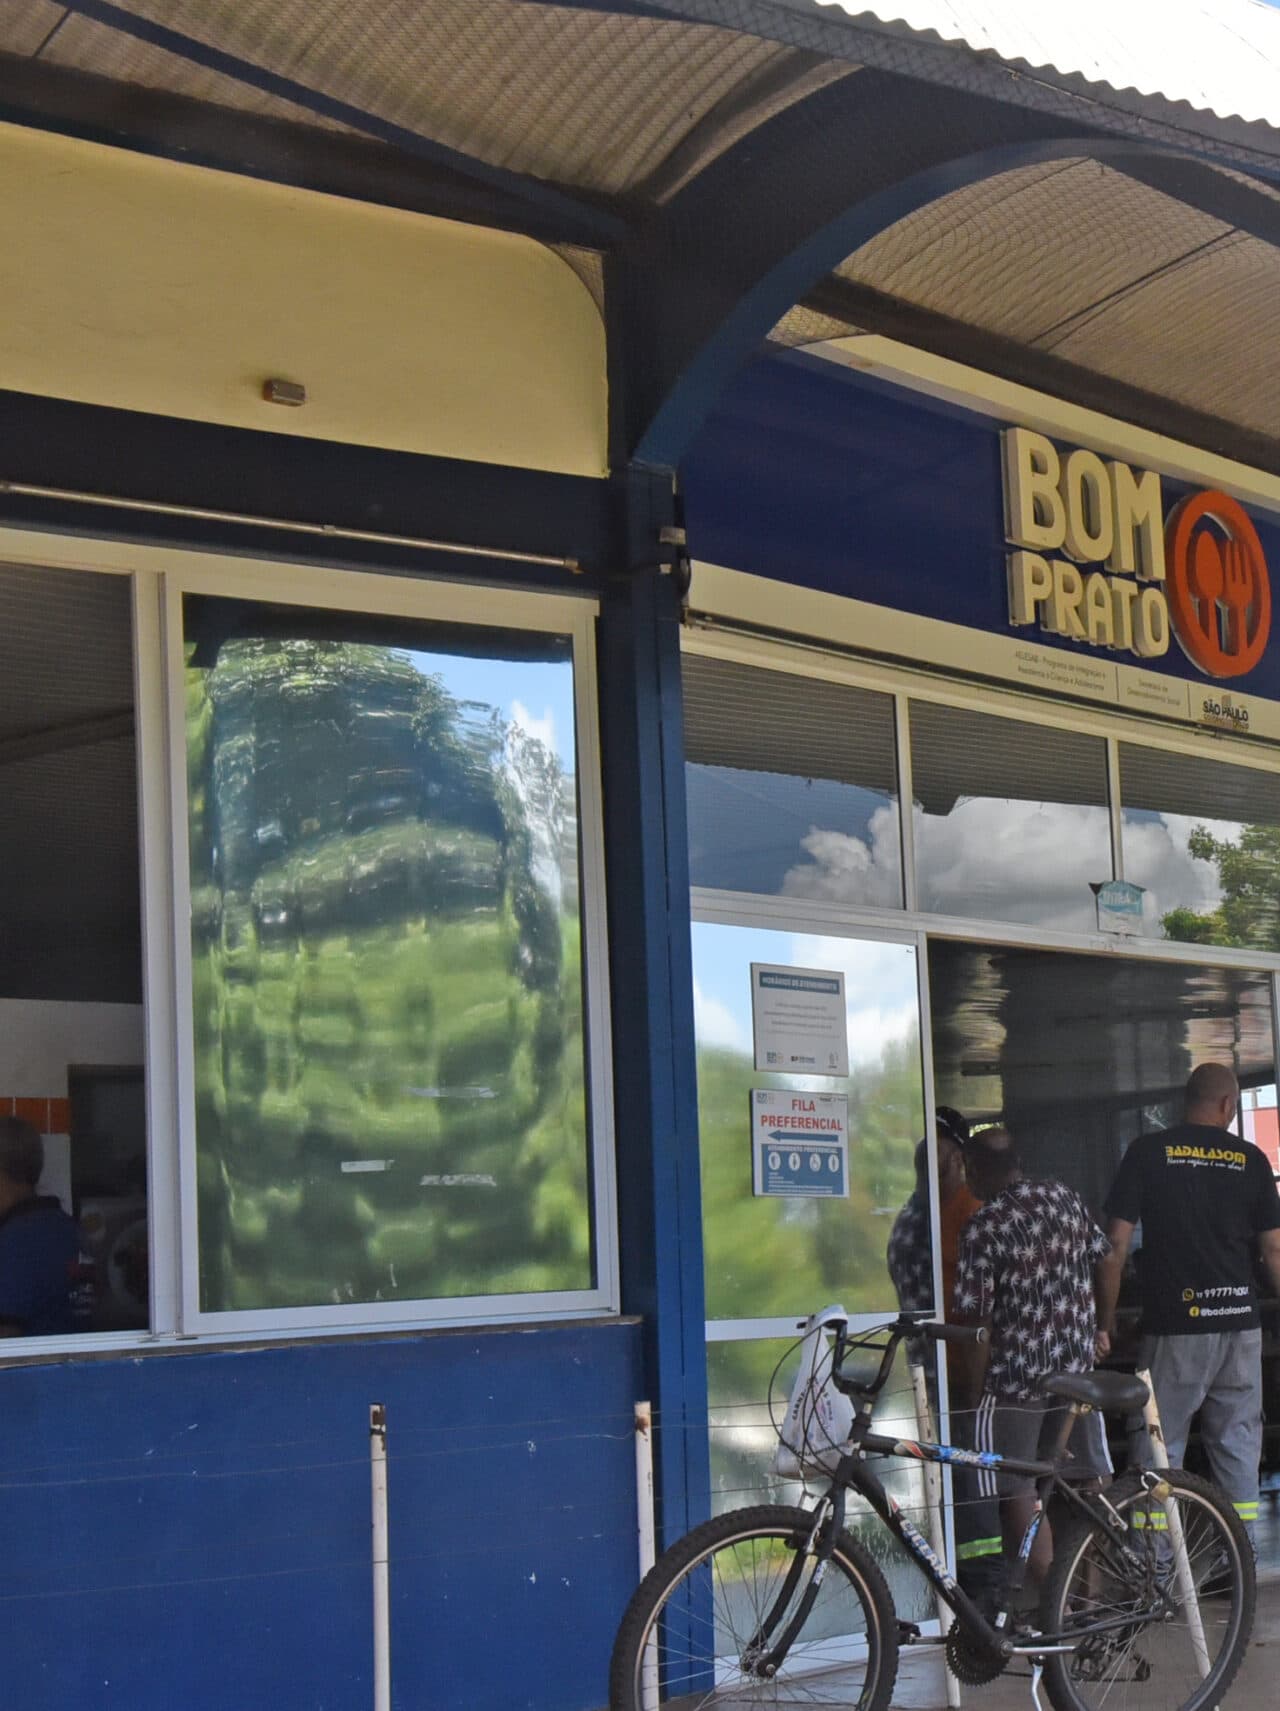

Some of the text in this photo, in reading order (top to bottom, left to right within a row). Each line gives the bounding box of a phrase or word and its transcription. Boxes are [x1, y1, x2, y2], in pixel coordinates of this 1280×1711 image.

[1002, 427, 1165, 581] BOM
[1006, 550, 1169, 657] PRATO
[1203, 699, 1220, 716] SÃO
[1222, 704, 1249, 722] PAULO
[792, 1099, 815, 1112] FILA
[761, 1115, 843, 1131] PREFERENCIAL
